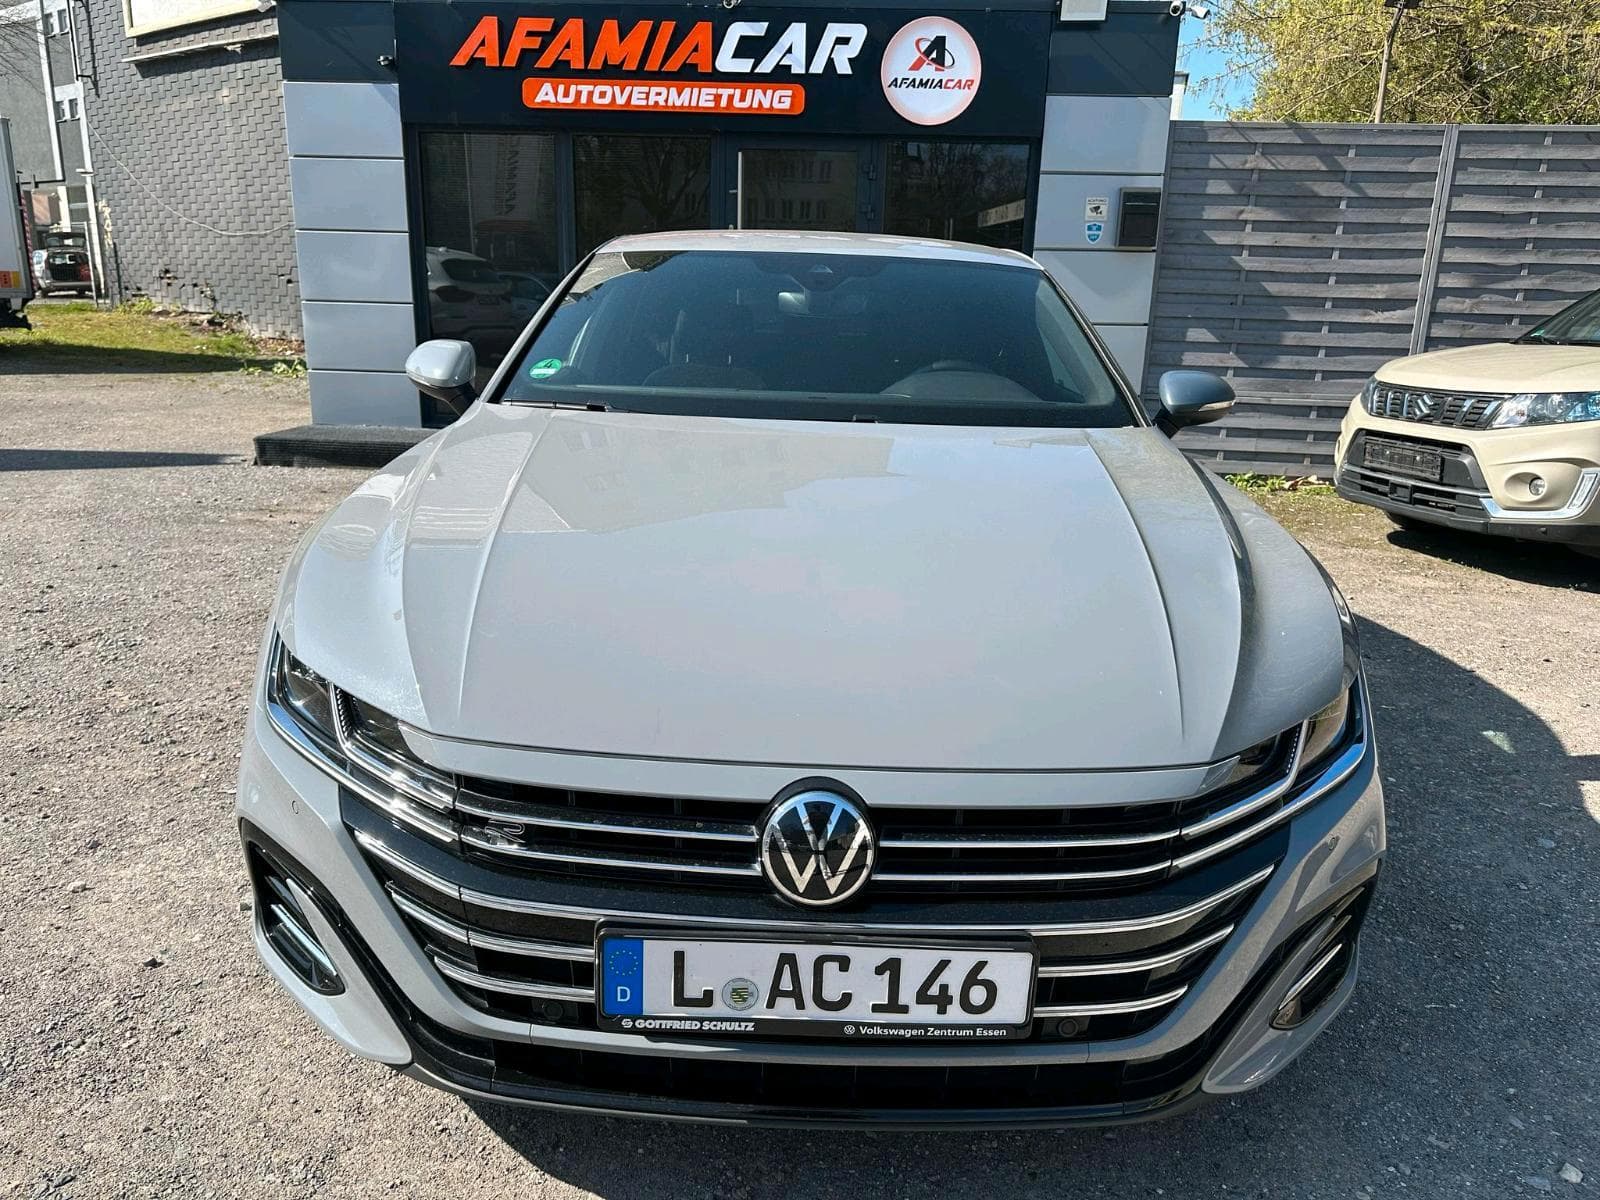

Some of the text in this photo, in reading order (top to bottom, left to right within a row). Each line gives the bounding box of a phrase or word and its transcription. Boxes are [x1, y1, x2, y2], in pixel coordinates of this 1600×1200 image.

[449, 15, 867, 75] AFAMIACAR
[888, 76, 975, 91] AFAMIACAR
[533, 81, 793, 109] AUTOVERMIETUNG
[672, 950, 714, 1009] L
[764, 952, 853, 1011] AC
[871, 956, 998, 1015] 146
[617, 985, 630, 1002] D
[635, 1018, 755, 1032] GOTTFRIED SCHULTZ
[859, 1025, 925, 1038] Volkswagen
[926, 1026, 974, 1037] Zentrum
[976, 1027, 1007, 1037] Essen
